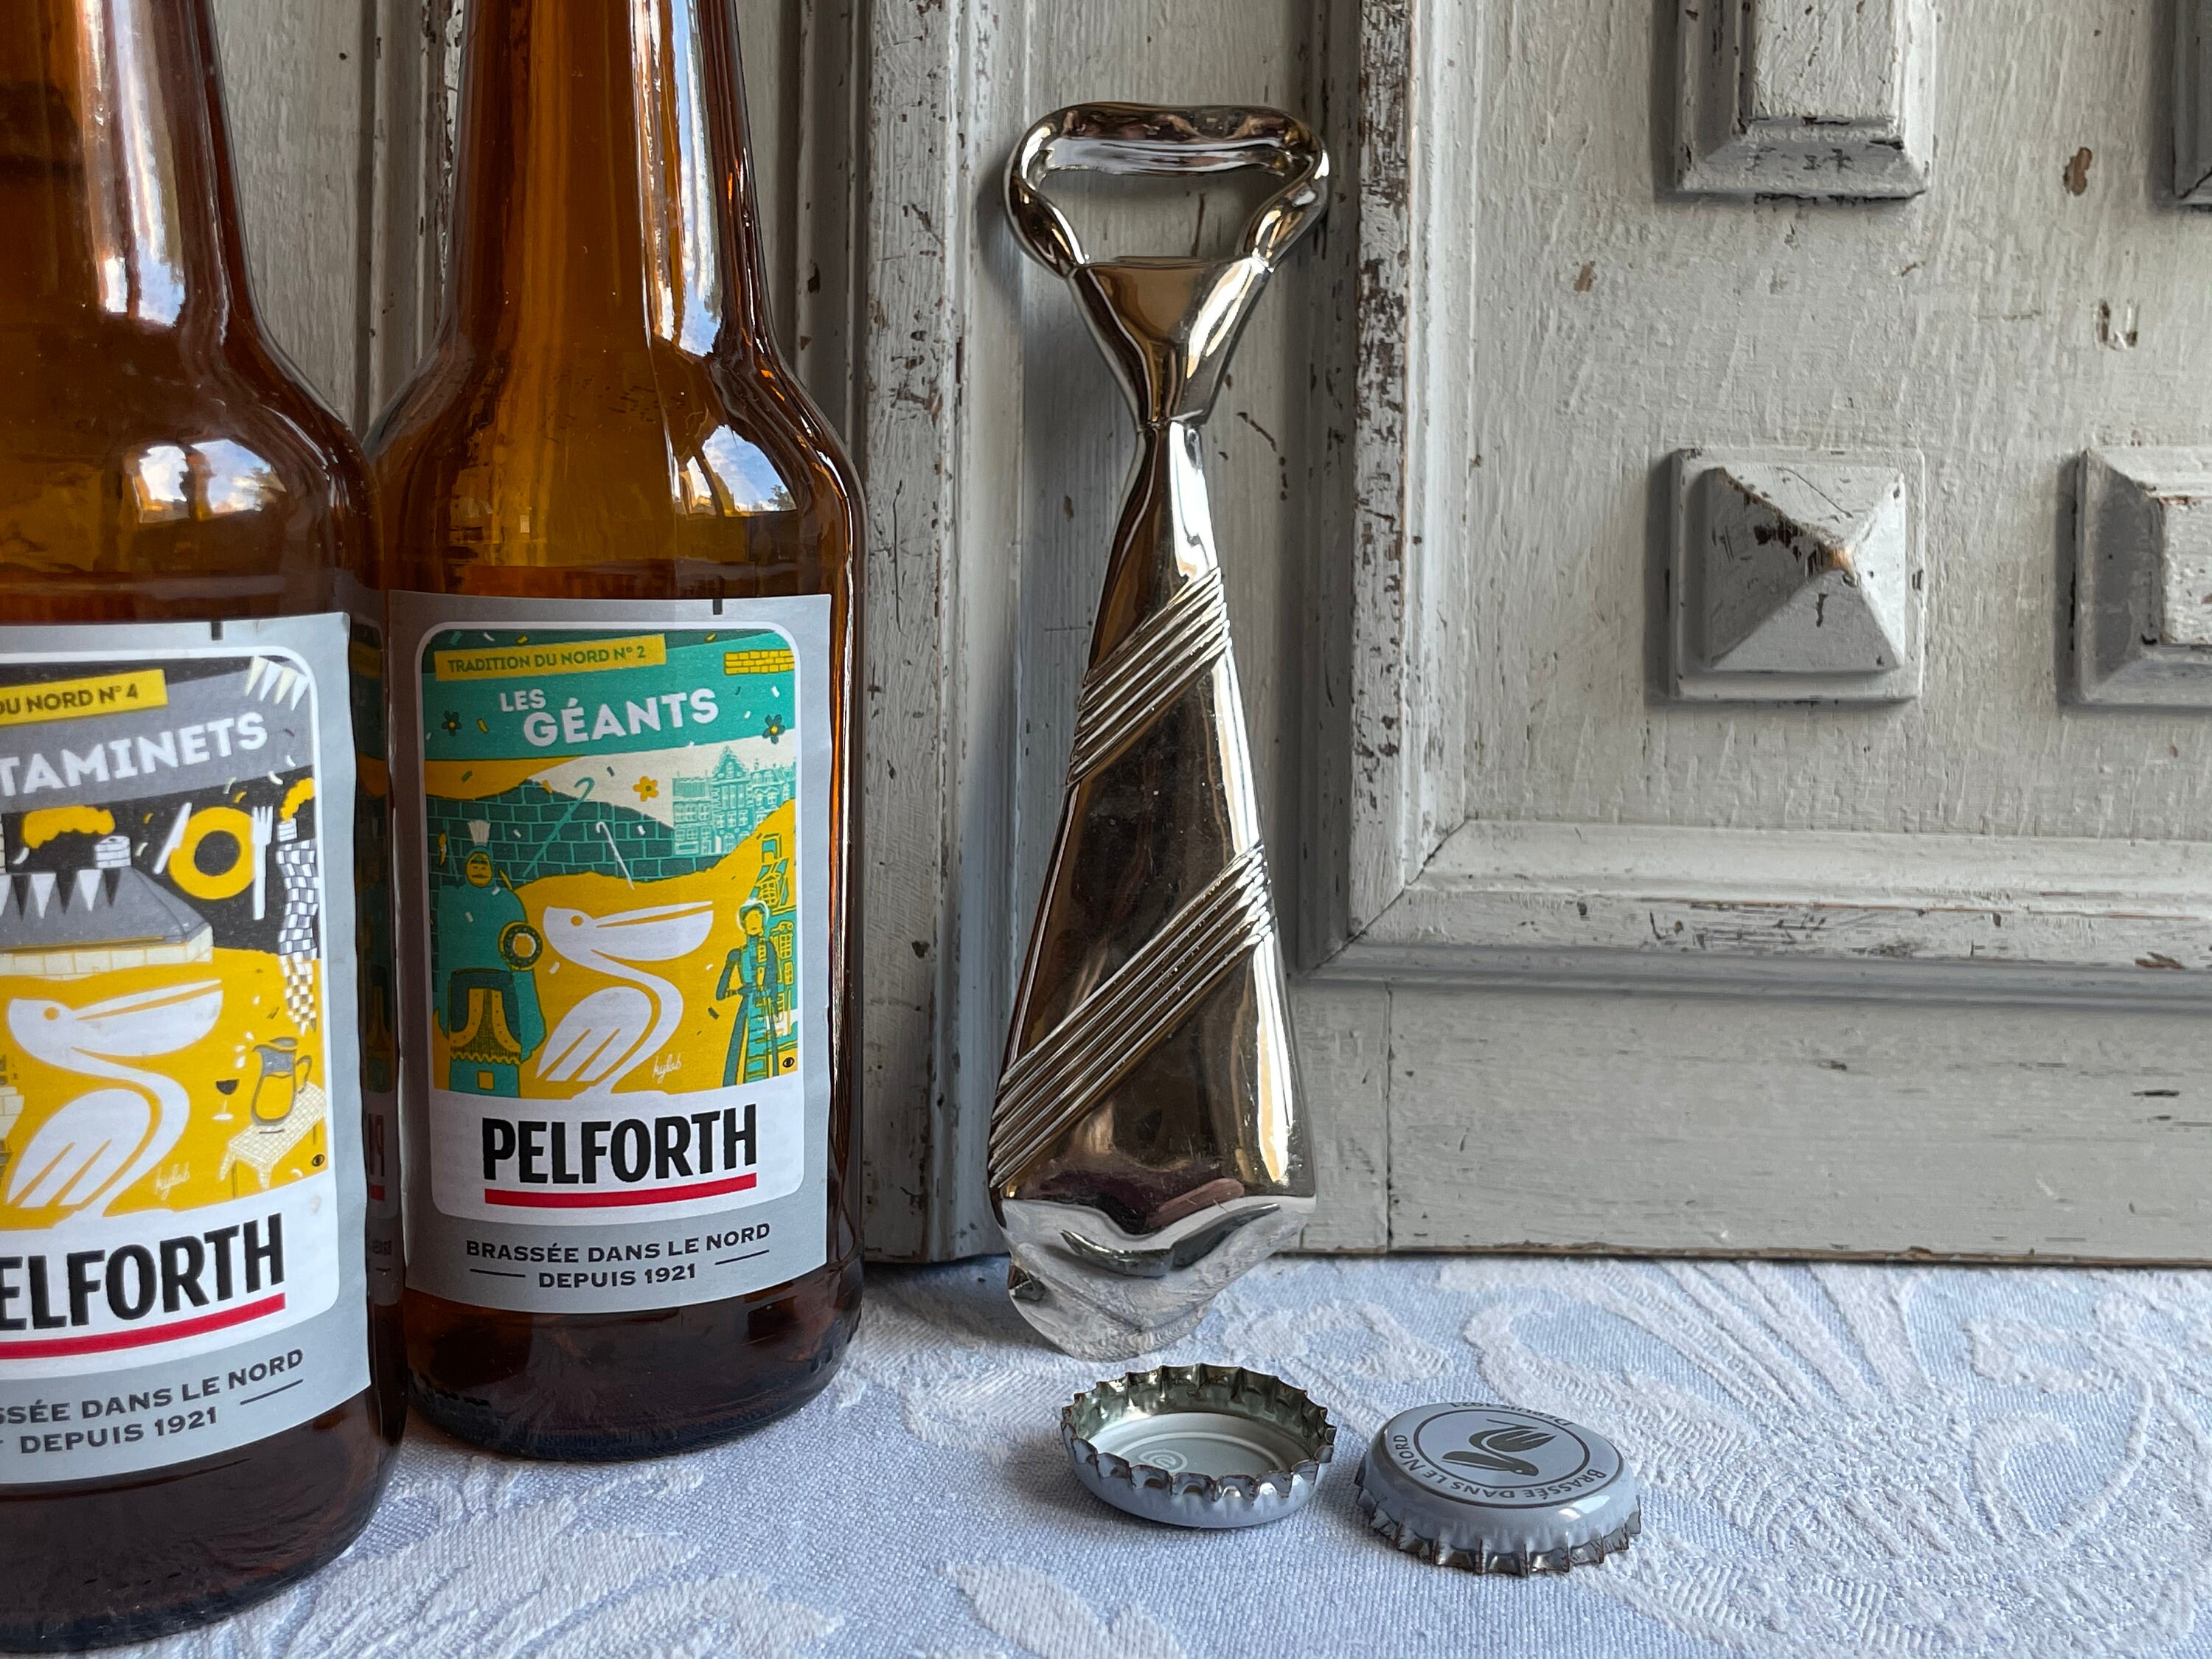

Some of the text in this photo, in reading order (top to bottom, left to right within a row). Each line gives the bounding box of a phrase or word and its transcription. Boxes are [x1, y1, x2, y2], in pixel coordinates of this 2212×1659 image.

[448, 654, 531, 672] TRADITION
[534, 653, 557, 667] DU
[561, 649, 610, 664] NORD
[637, 645, 646, 658] 2
[27, 689, 93, 713] NORD
[126, 684, 139, 699] 4
[500, 689, 546, 712] LES
[524, 688, 719, 747] GÉANTS
[0, 712, 268, 797] TAMINETS
[482, 1103, 757, 1184] PELFORTH
[466, 1222, 771, 1264] BRASSÉE DANS LE NORD
[0, 1212, 285, 1331] ELFORTH
[538, 1263, 696, 1289] DEPUIS 1921
[0, 1349, 304, 1425] SÉE DANS LE NORD
[20, 1406, 218, 1454] DEPUIS 1921
[1393, 1435, 1607, 1500] BRASSÉE DANS LE NORD
